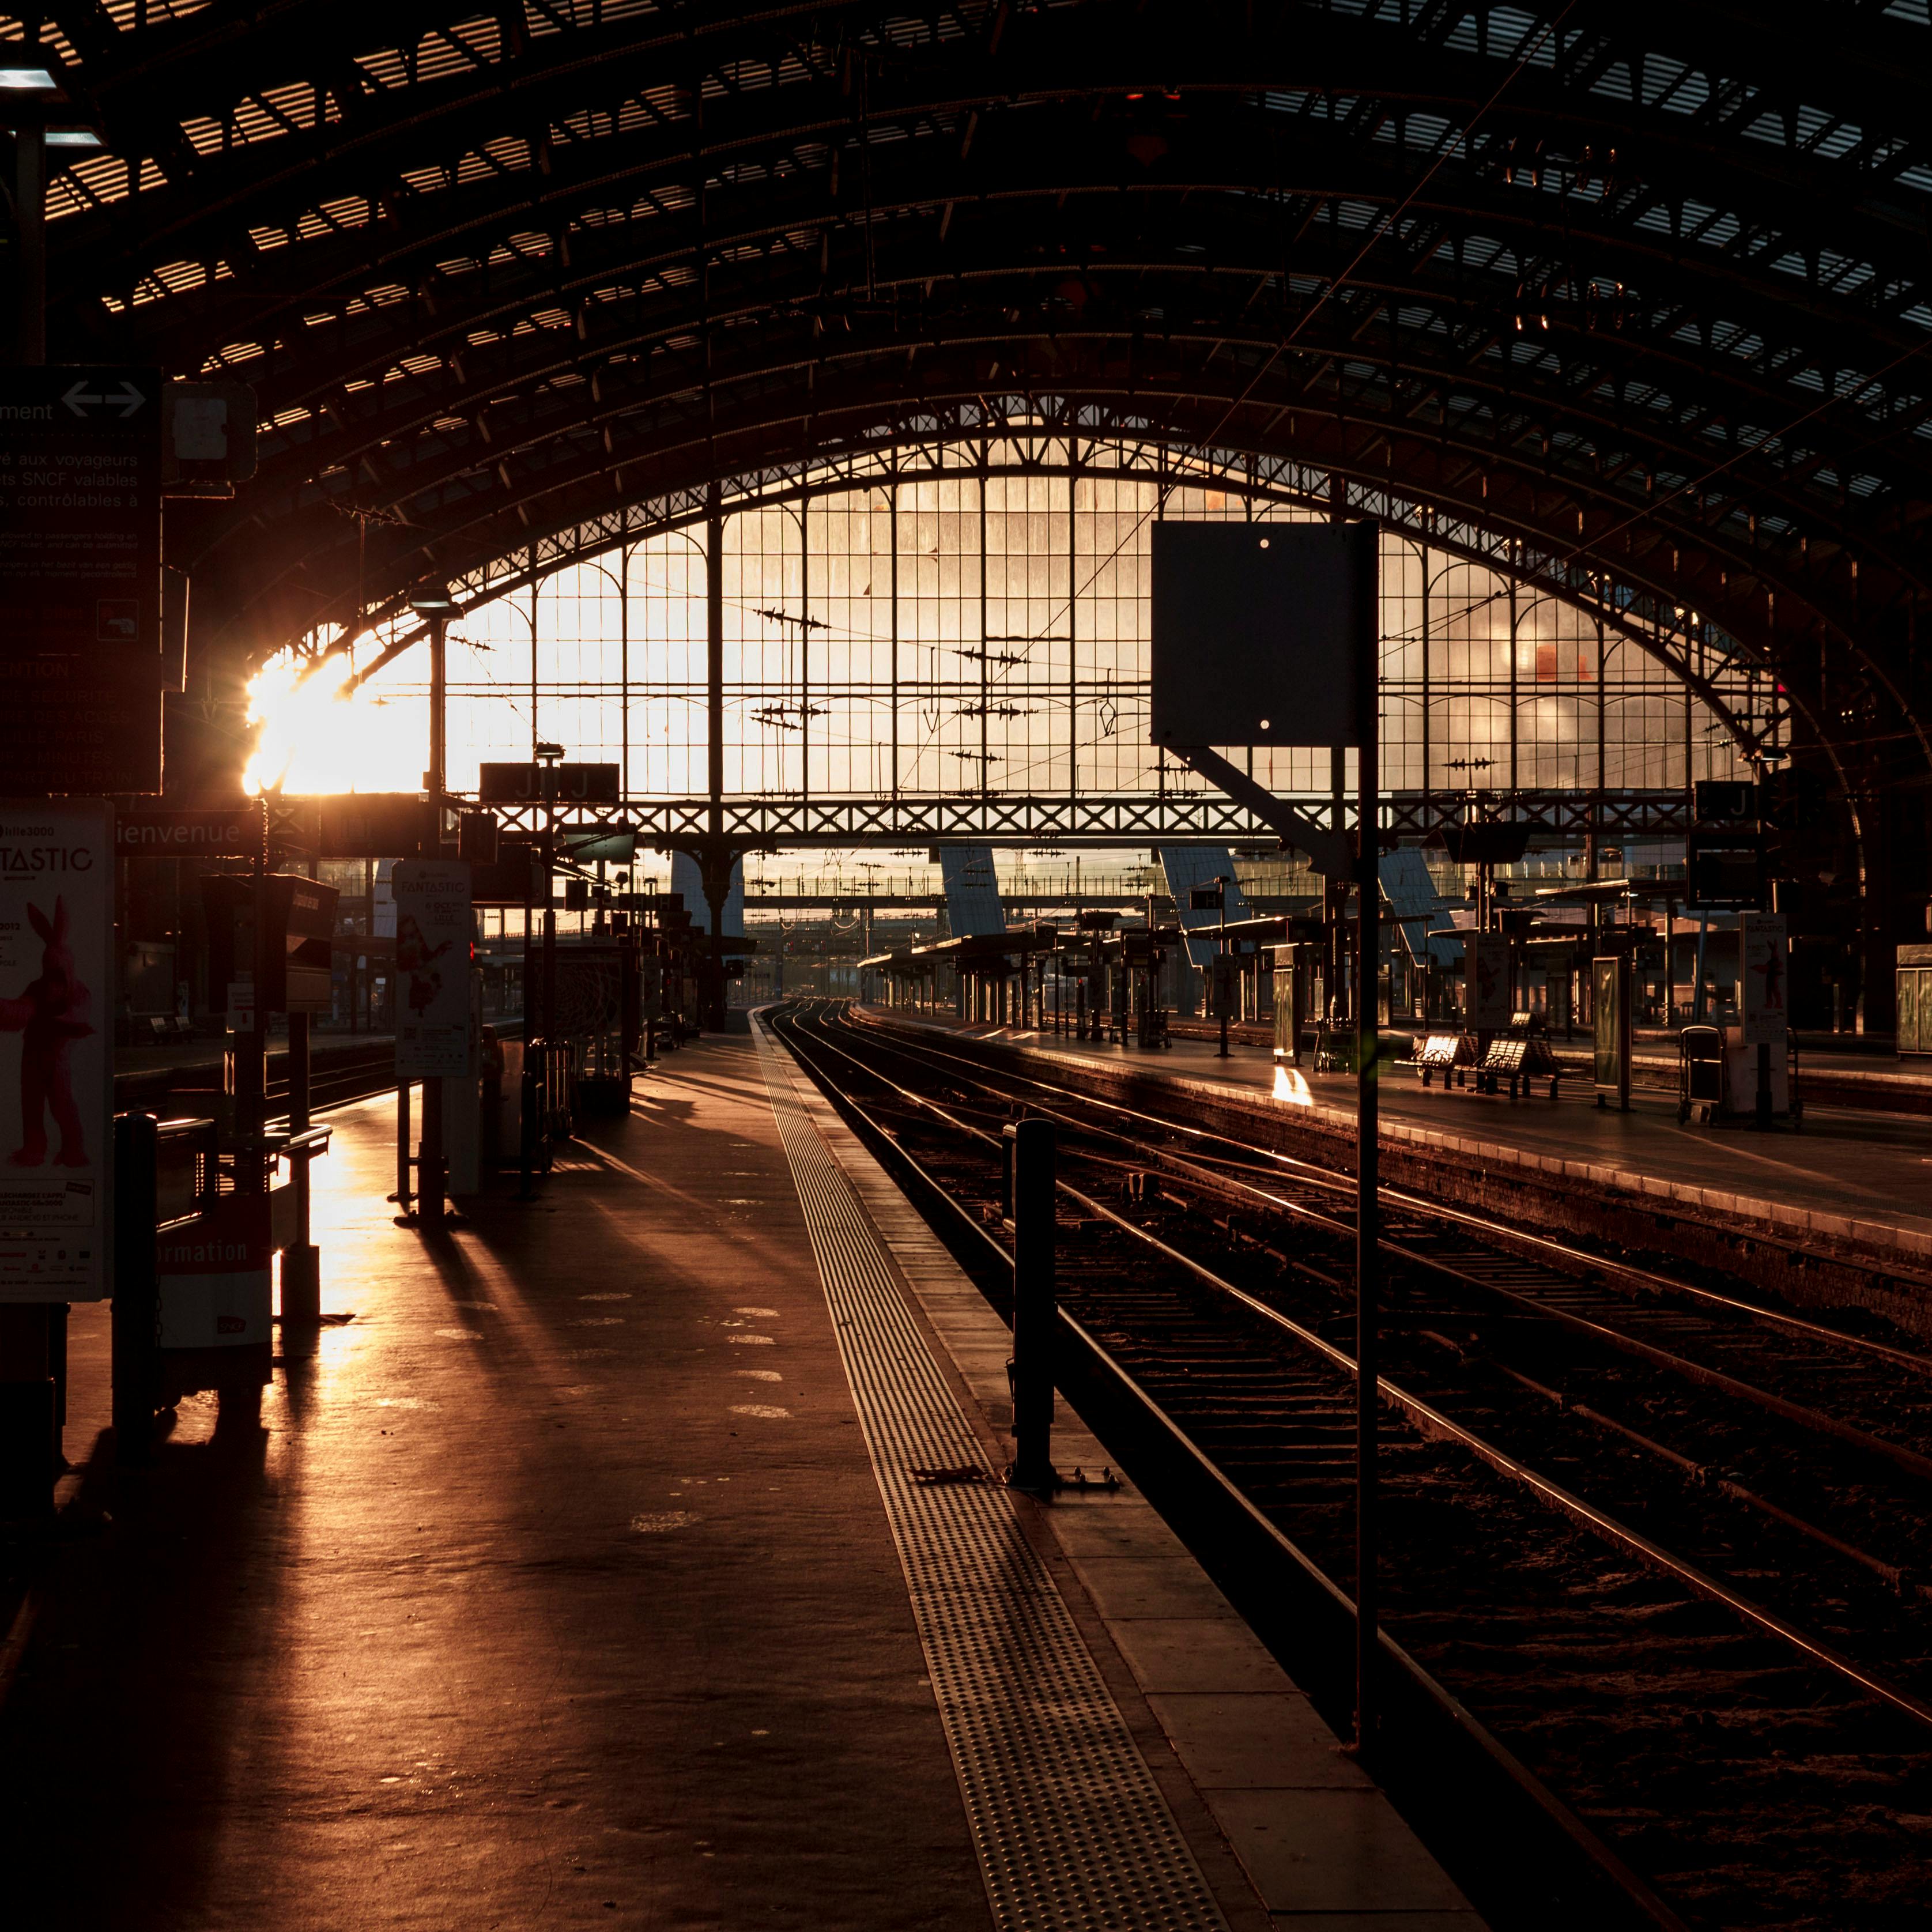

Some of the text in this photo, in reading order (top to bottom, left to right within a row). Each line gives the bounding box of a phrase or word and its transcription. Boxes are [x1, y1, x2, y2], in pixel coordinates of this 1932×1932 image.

[0, 403, 53, 420] ment
[18, 455, 48, 466] aux
[55, 455, 138, 470] voyageurs
[22, 471, 67, 486] SNCF
[74, 472, 138, 487] valables
[17, 492, 122, 507] contrôlables
[514, 770, 532, 798] J
[570, 771, 588, 799] J
[1730, 789, 1746, 816] J
[115, 820, 240, 844] ienvenue
[401, 881, 465, 893] FANTASTIC
[659, 896, 671, 910] H
[1206, 895, 1216, 908] H
[1044, 928, 1052, 938] G
